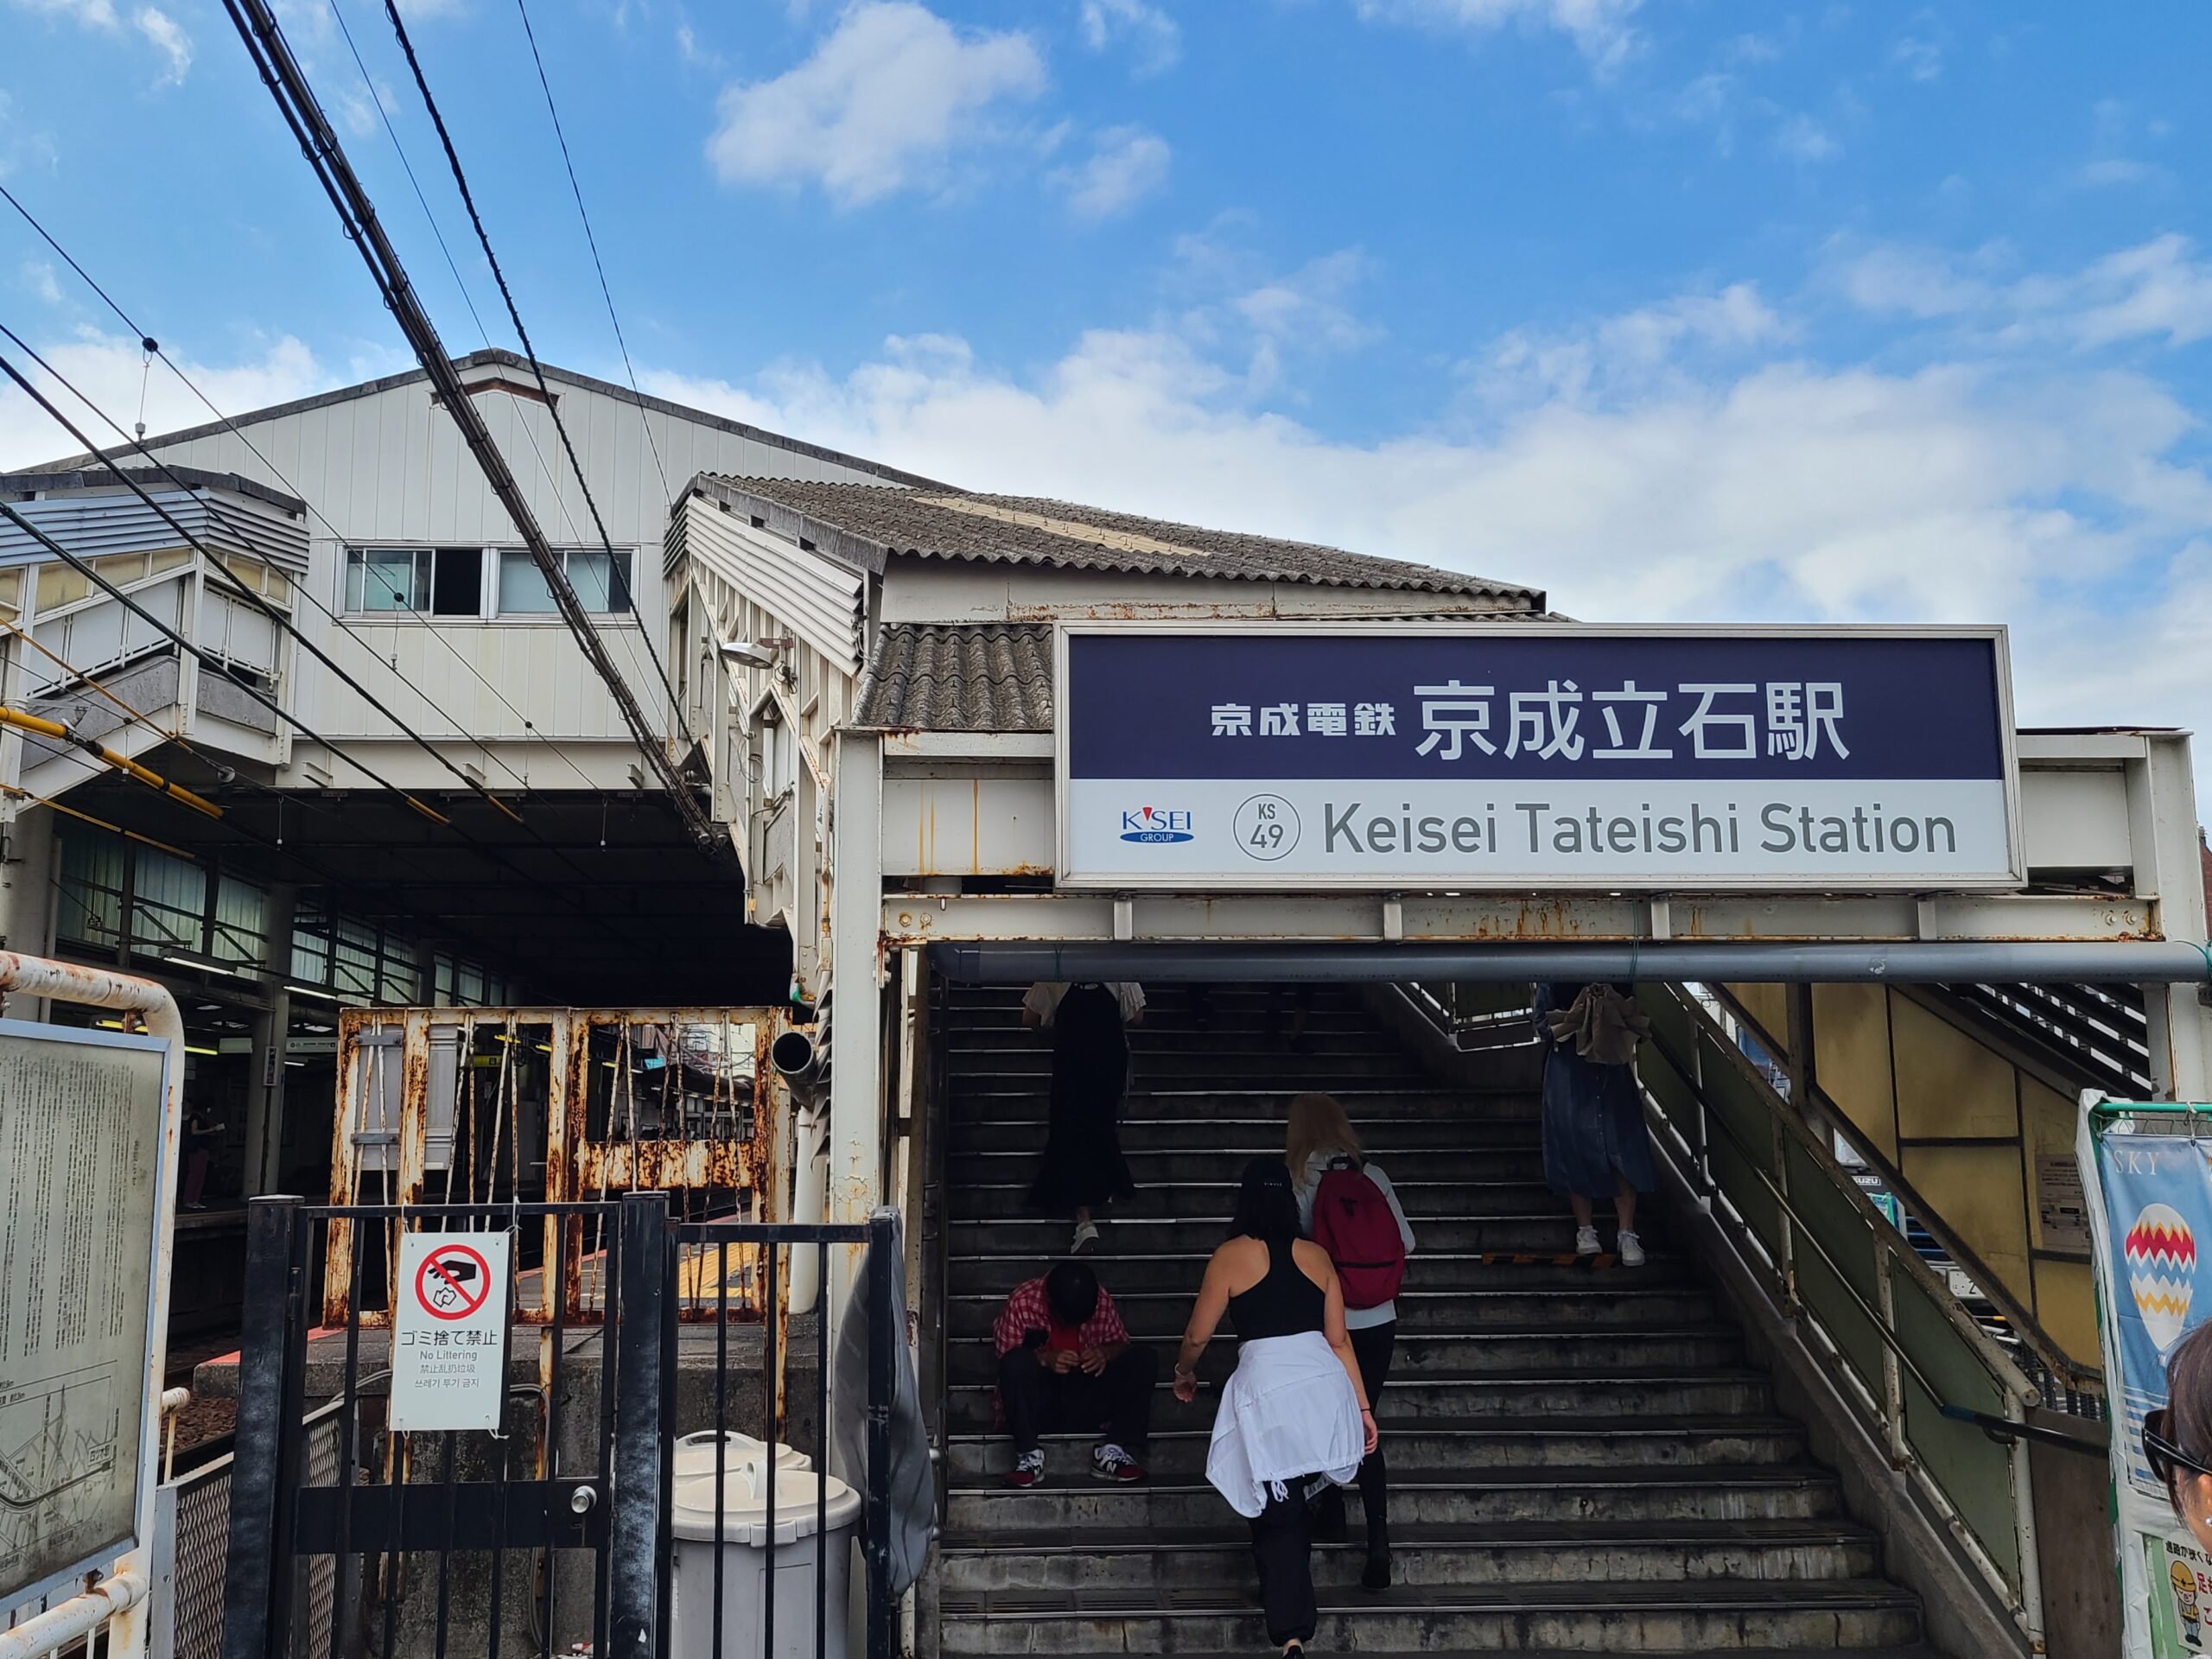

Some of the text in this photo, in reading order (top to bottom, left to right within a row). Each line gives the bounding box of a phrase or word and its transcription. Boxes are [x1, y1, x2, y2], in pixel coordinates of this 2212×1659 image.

[1211, 679, 1850, 761] 京成電鉄 京成立石駅
[1258, 803, 1276, 820] KS
[1249, 823, 1284, 849] 49
[1324, 803, 1956, 854] Keisei Tateishi Station
[1140, 833, 1174, 842] GROUP
[2113, 1149, 2159, 1175] SKY
[401, 1329, 498, 1346] ゴミ捨て禁止
[420, 1350, 478, 1362] No Littering
[420, 1363, 475, 1375] 禁止乱扔垃圾
[415, 1377, 480, 1389] 쓰레기 투기 금지
